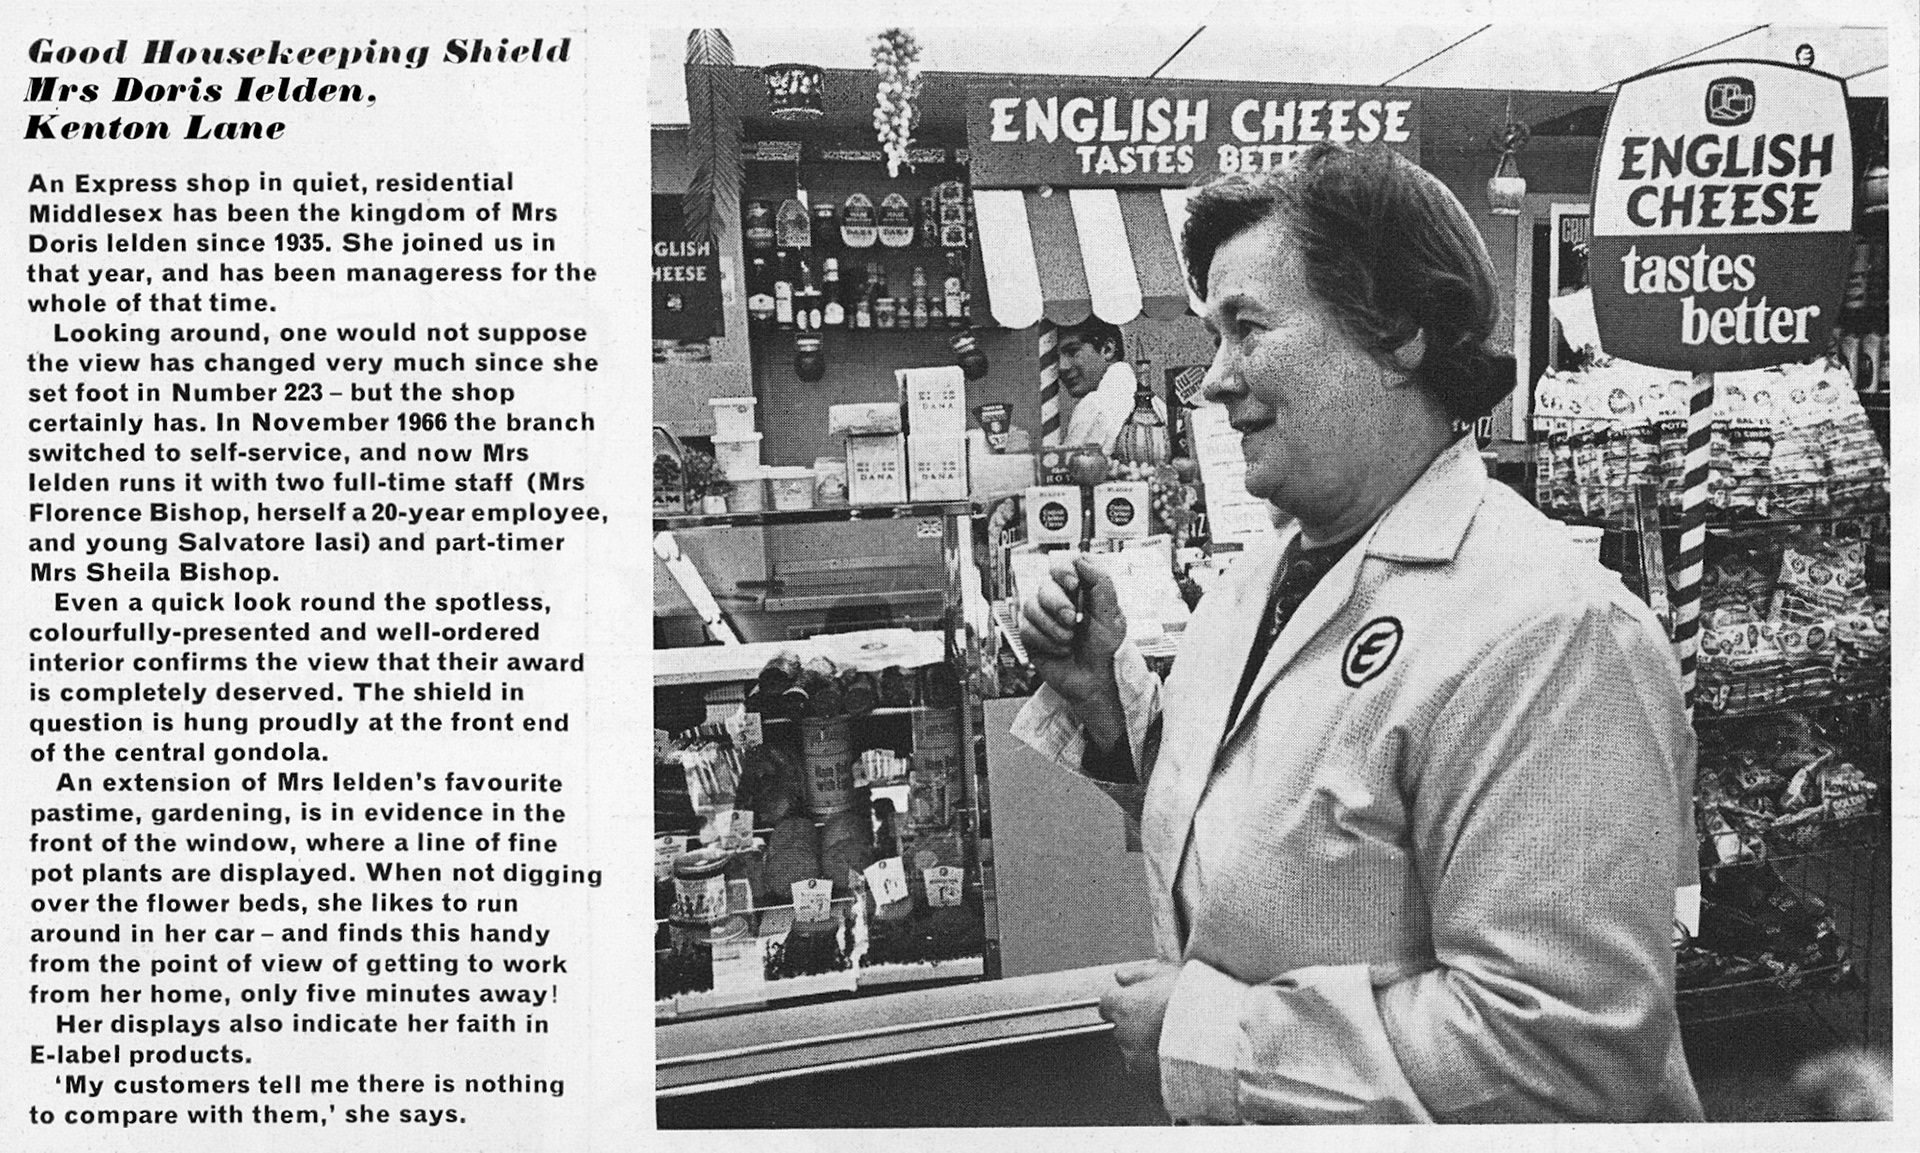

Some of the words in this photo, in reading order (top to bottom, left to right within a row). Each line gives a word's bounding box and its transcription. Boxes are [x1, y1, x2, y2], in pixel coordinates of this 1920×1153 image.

[28, 38, 128, 65] Good
[143, 38, 430, 70] Housekeeping
[442, 37, 571, 64] Shield
[22, 76, 100, 103] Mrs
[111, 76, 223, 103] Doris
[234, 76, 378, 108] Ielden,
[23, 114, 169, 140] Kenton
[183, 114, 286, 140] Lane
[989, 95, 1209, 144] ENGLISH
[1231, 99, 1413, 143] CHEESE
[1076, 144, 1195, 175] TASTES
[1617, 132, 1835, 181] ENGLISH
[27, 173, 64, 193] An
[75, 173, 177, 196] Express
[186, 172, 250, 197] shop
[259, 170, 282, 192] in
[292, 171, 368, 196] quiet,
[376, 171, 513, 193] residential
[29, 203, 163, 224] Middlesex
[173, 202, 218, 223] has
[228, 203, 289, 223] been
[297, 202, 340, 223] the
[350, 202, 465, 226] kingdom
[475, 201, 501, 222] of
[512, 202, 558, 222] Mrs
[1625, 182, 1822, 228] CHEESE
[29, 233, 98, 254] Doris
[107, 232, 187, 253] Ielden
[196, 232, 266, 253] since
[274, 232, 332, 253] 1935.
[342, 232, 394, 253] She
[401, 232, 483, 256] joined
[494, 237, 523, 252] us
[532, 232, 555, 252] in
[653, 240, 711, 257] GLISH
[26, 263, 80, 283] that
[88, 267, 152, 287] year,
[162, 262, 209, 282] and
[220, 262, 264, 282] has
[274, 262, 336, 282] been
[347, 267, 503, 286] manageress
[511, 261, 548, 282] for
[554, 262, 597, 282] the
[1621, 243, 1756, 296] tastes
[27, 293, 107, 313] whole
[116, 292, 142, 313] of
[148, 292, 202, 312] that
[208, 292, 276, 312] time.
[1681, 296, 1821, 346] better
[54, 322, 160, 346] Looking
[170, 322, 269, 346] around,
[279, 327, 327, 342] one
[336, 322, 416, 342] would
[427, 322, 470, 342] not
[477, 326, 587, 346] suppose
[26, 352, 69, 373] the
[78, 352, 141, 373] view
[150, 352, 195, 372] has
[204, 352, 315, 376] changed
[326, 357, 383, 375] very
[394, 352, 465, 372] much
[475, 352, 544, 372] since
[553, 352, 599, 372] she
[28, 383, 68, 403] set
[75, 382, 129, 403] foot
[137, 382, 160, 402] in
[172, 382, 278, 402] Number
[284, 382, 323, 402] 223
[351, 382, 393, 402] but
[399, 381, 443, 402] the
[451, 382, 515, 406] shop
[28, 412, 144, 436] certainly
[154, 412, 206, 432] has.
[216, 412, 240, 432] In
[252, 412, 390, 432] November
[397, 412, 448, 432] 1966
[454, 411, 497, 432] the
[506, 411, 595, 432] branch
[28, 442, 145, 463] switched
[154, 442, 181, 462] to
[190, 441, 350, 465] self-service,
[359, 441, 406, 462] and
[417, 447, 473, 463] now
[483, 443, 529, 463] Mrs
[29, 472, 109, 493] Ielden
[119, 477, 176, 493] runs
[185, 472, 203, 492] it
[211, 472, 267, 492] with
[275, 472, 325, 492] two
[333, 471, 446, 492] full-time
[454, 472, 513, 492] staff
[527, 471, 585, 495] (Mrs
[29, 502, 142, 523] Florence
[150, 502, 249, 526] Bishop,
[257, 501, 347, 522] herself
[352, 506, 367, 522] a
[371, 502, 466, 525] 20-year
[471, 502, 608, 526] employee,
[28, 532, 75, 552] and
[85, 537, 168, 556] young
[178, 531, 305, 552] Salvatore
[315, 531, 370, 555] Iasi)
[378, 532, 425, 552] and
[436, 532, 565, 556] part-timer
[31, 562, 77, 582] Mrs
[86, 561, 171, 582] Sheila
[180, 561, 279, 585] Bishop.
[29, 652, 125, 672] interior
[133, 651, 248, 672] confirms
[255, 651, 298, 672] the
[307, 652, 369, 672] view
[376, 651, 430, 672] that
[436, 651, 499, 672] their
[506, 652, 584, 672] award
[30, 742, 56, 763] of
[63, 742, 106, 762] the
[114, 742, 205, 762] central
[214, 741, 328, 766] gondola.
[56, 1014, 103, 1034] Her
[110, 1013, 221, 1037] displays
[229, 1013, 283, 1033] also
[293, 1013, 398, 1033] indicate
[408, 1013, 449, 1033] her
[456, 1013, 516, 1033] faith
[526, 1014, 548, 1034] in
[30, 1044, 120, 1064] E-label
[129, 1044, 252, 1068] products.
